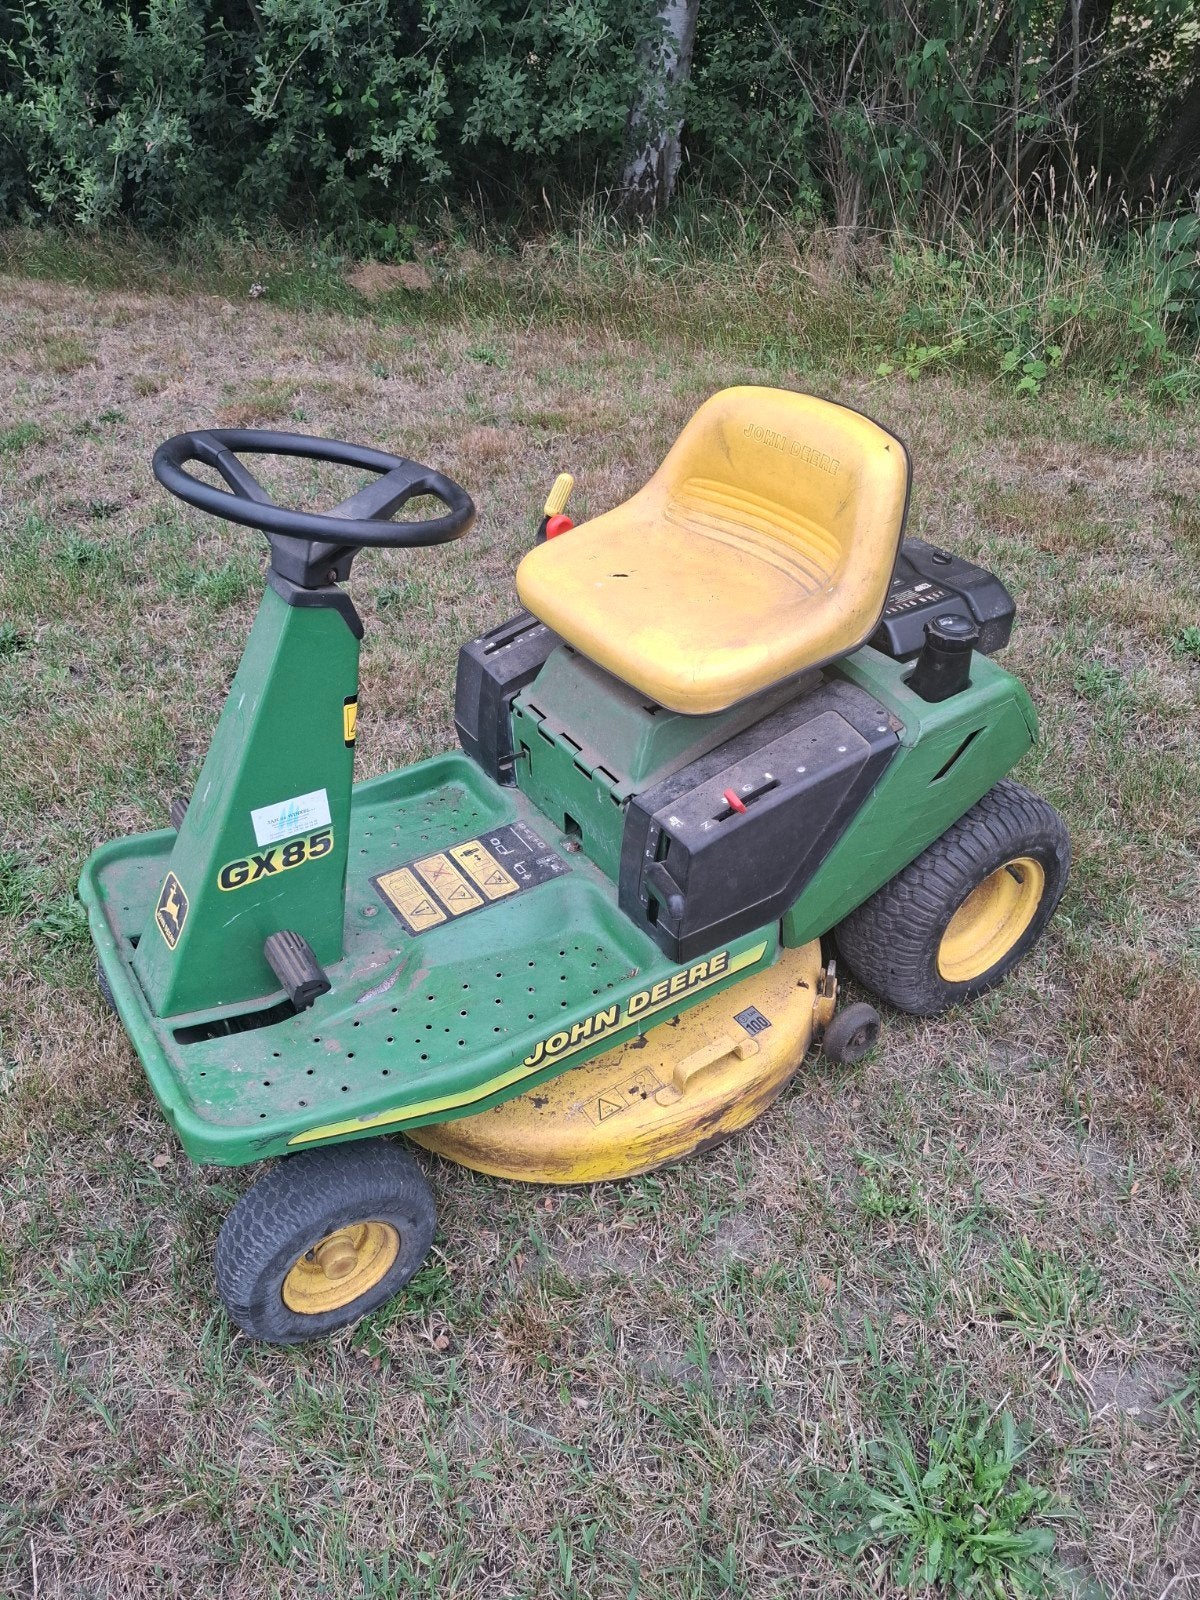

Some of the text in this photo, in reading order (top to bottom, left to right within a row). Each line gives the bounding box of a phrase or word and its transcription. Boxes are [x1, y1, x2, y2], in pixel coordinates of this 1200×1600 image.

[743, 423, 841, 476] JOHN DEERE
[220, 829, 332, 888] GX85
[523, 950, 730, 1067] JOHN DEERE
[746, 1016, 768, 1033] 100
